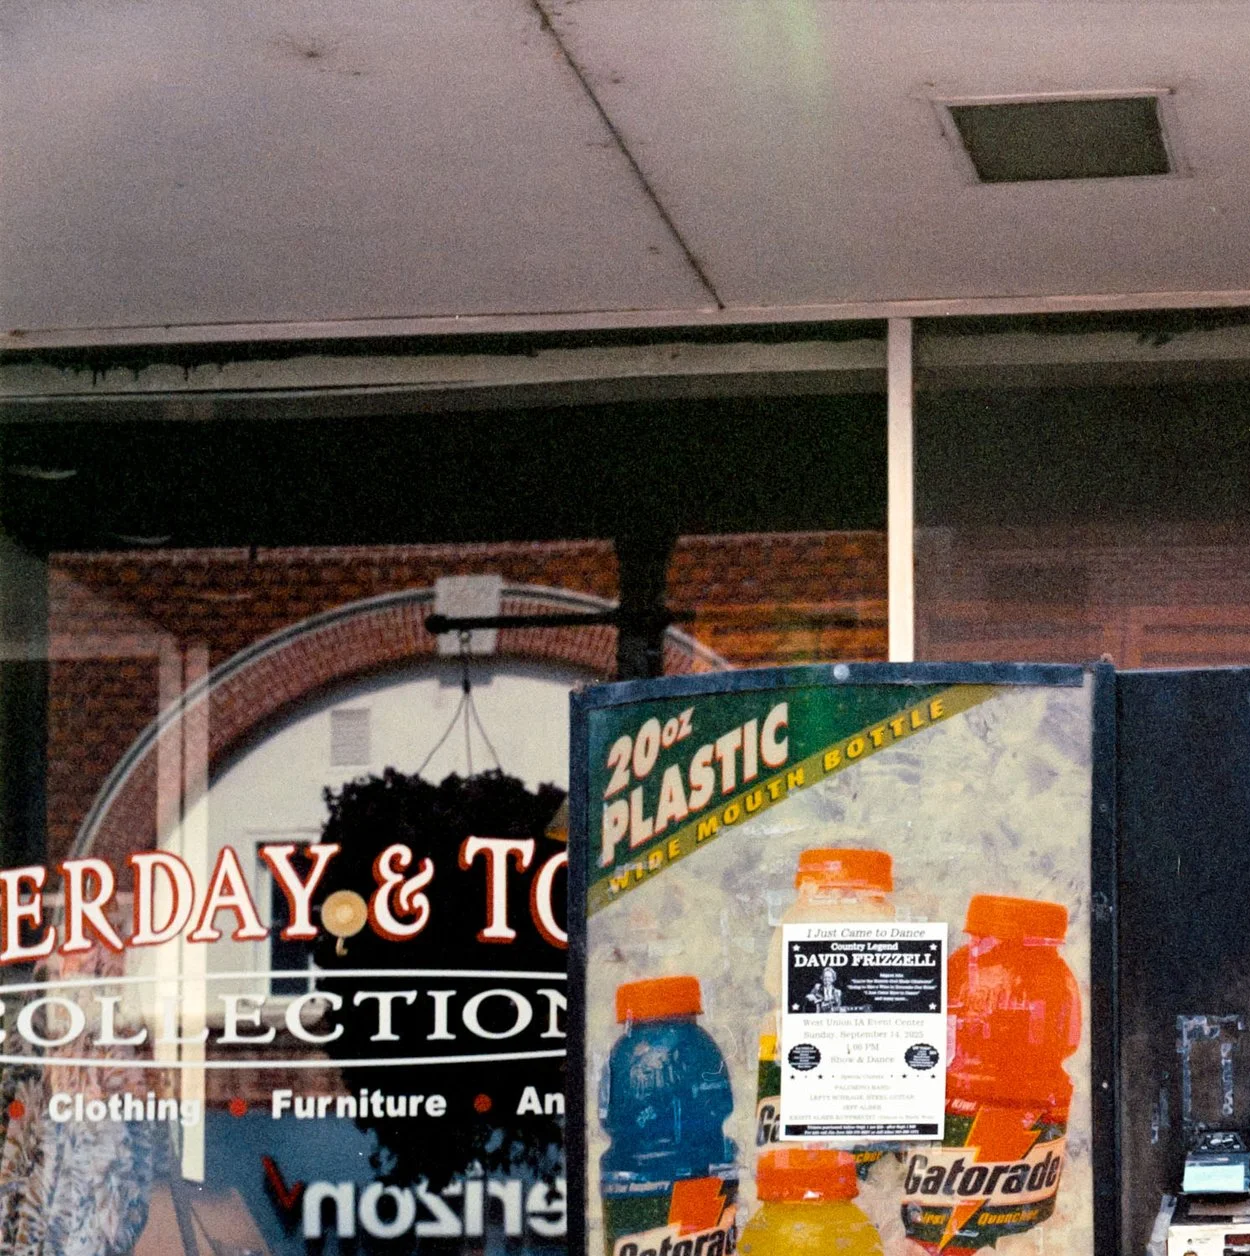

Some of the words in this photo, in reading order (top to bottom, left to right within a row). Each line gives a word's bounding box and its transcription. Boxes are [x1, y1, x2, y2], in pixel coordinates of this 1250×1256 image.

[600, 702, 789, 868] PLASTIC
[608, 838, 681, 894] WIDE
[696, 769, 805, 842] MOUTH
[824, 699, 945, 772] BOTTLE
[367, 844, 435, 943] &
[813, 929, 837, 938] Just
[841, 928, 873, 938] Came
[875, 929, 887, 938] to
[891, 928, 925, 938] Dance
[831, 942, 865, 952] Country
[867, 942, 899, 952] Legend
[794, 954, 848, 967] DAVID
[852, 953, 936, 967] FRIZZELL
[48, 1092, 201, 1127] Clothing
[272, 1089, 447, 1119] Furniture
[904, 1150, 1061, 1196] Gatorade
